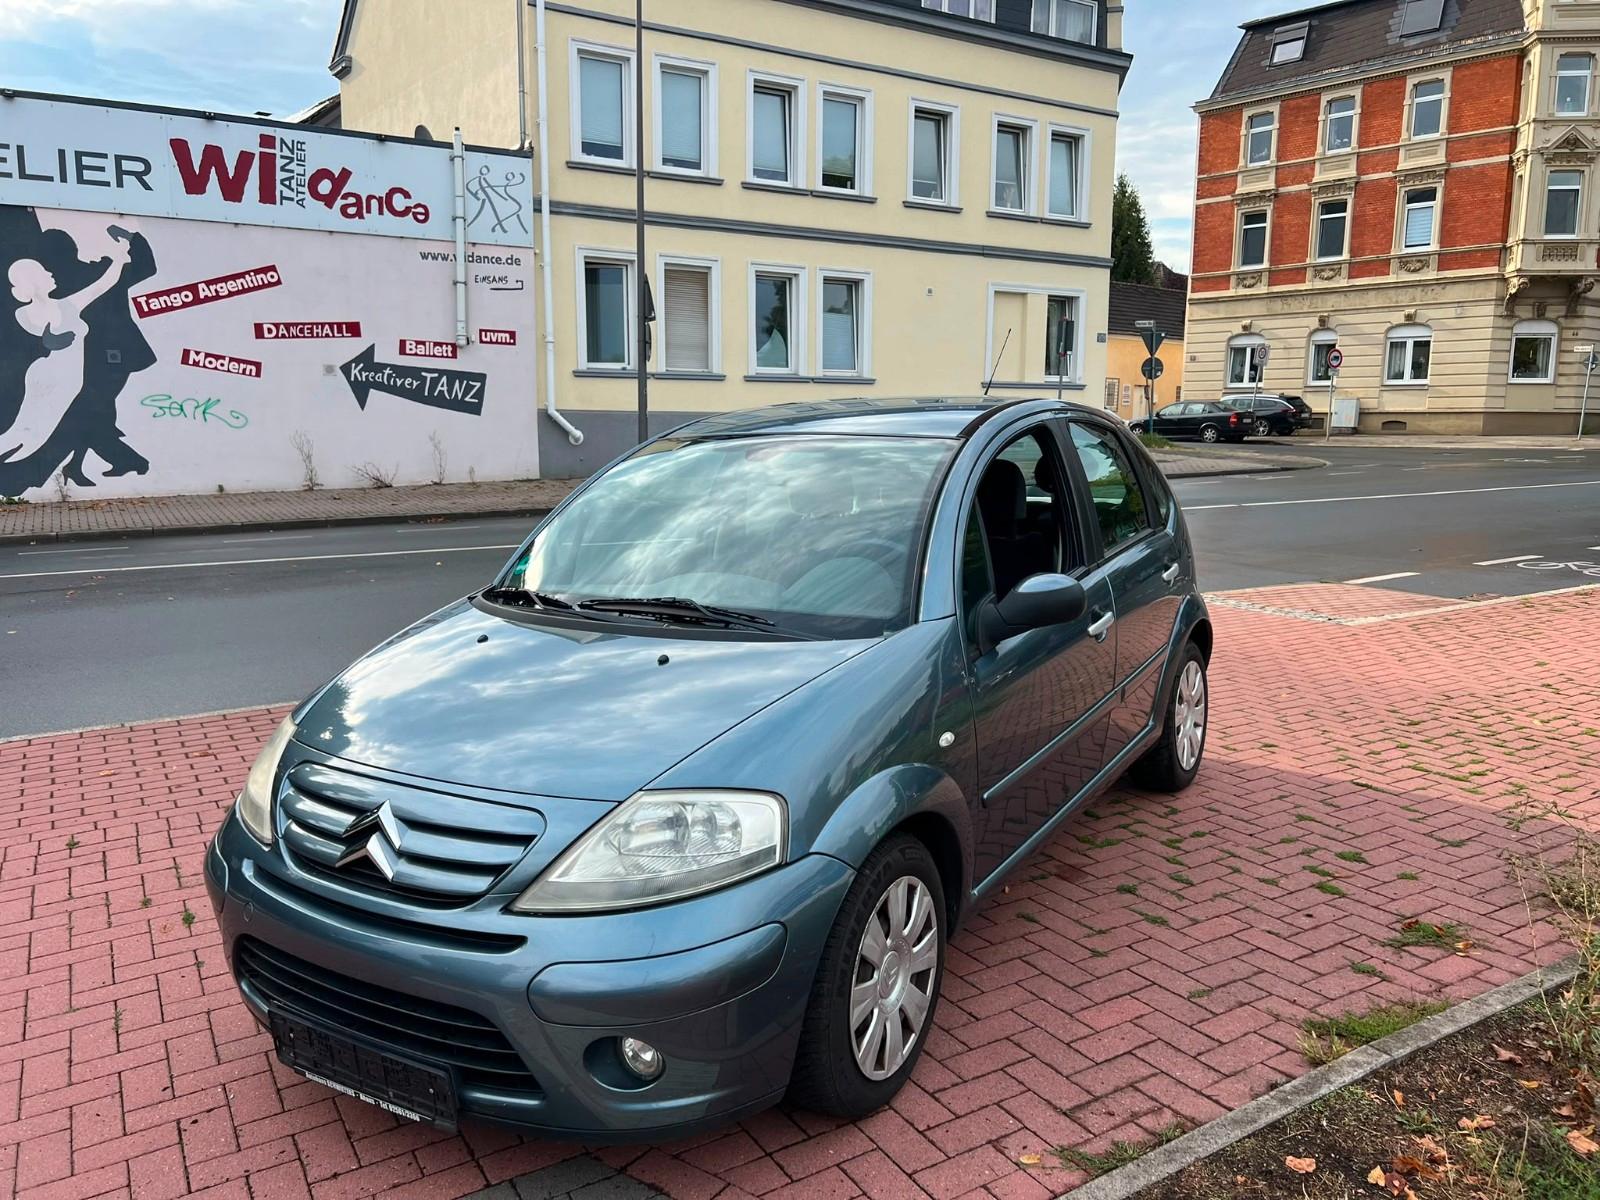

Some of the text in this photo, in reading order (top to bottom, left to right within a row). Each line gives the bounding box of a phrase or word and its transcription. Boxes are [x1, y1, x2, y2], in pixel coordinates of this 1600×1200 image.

[279, 136, 296, 206] TANZ
[295, 140, 307, 209] ATELIER
[419, 250, 522, 267] www.idance.de
[136, 269, 279, 313] Tango Argentino
[405, 340, 453, 358] Ballett
[481, 330, 514, 344] uvm.
[188, 350, 257, 377] Modern
[350, 362, 482, 403] Kreativer TANZ
